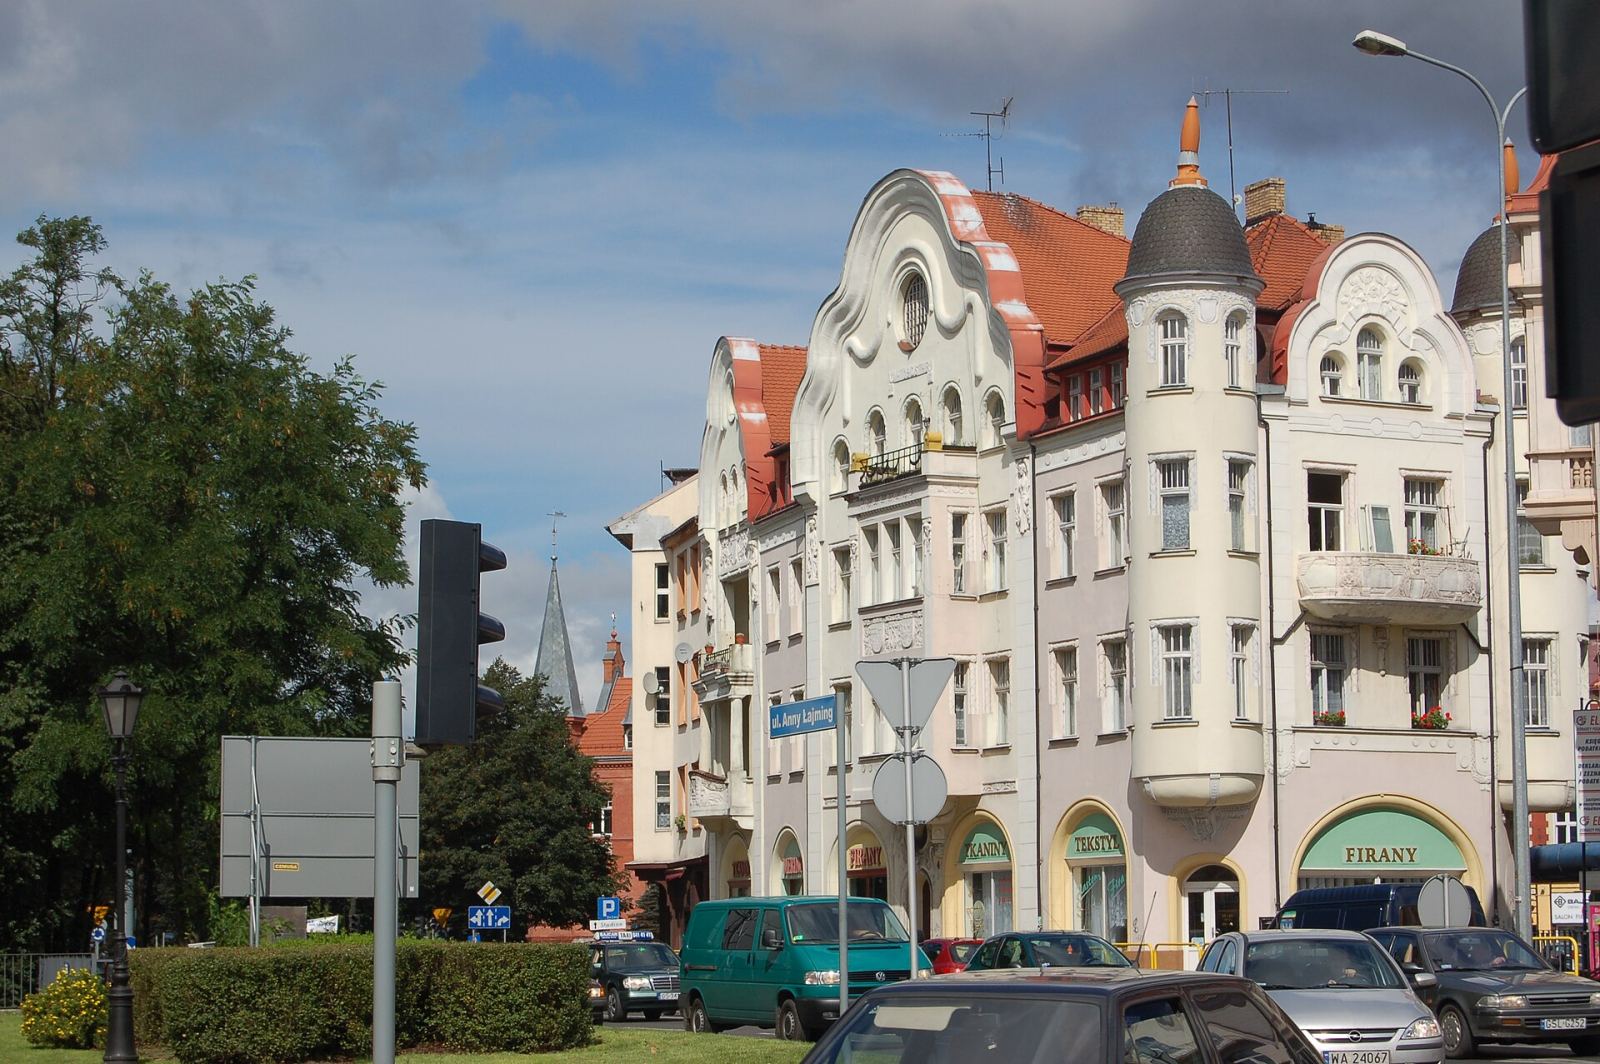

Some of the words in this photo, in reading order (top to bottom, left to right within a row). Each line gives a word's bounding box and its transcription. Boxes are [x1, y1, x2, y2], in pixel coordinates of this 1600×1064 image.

[772, 713, 781, 728] ul.
[782, 712, 801, 728] Anny
[802, 705, 833, 726] Łajming
[965, 842, 1007, 857] TKANINY
[1074, 834, 1120, 852] TEKSTYL
[850, 846, 882, 867] FIRANY
[1345, 847, 1418, 863] FIRANY
[602, 900, 615, 917] P
[1331, 1053, 1348, 1063] WA
[1352, 1053, 1388, 1064] 24067
